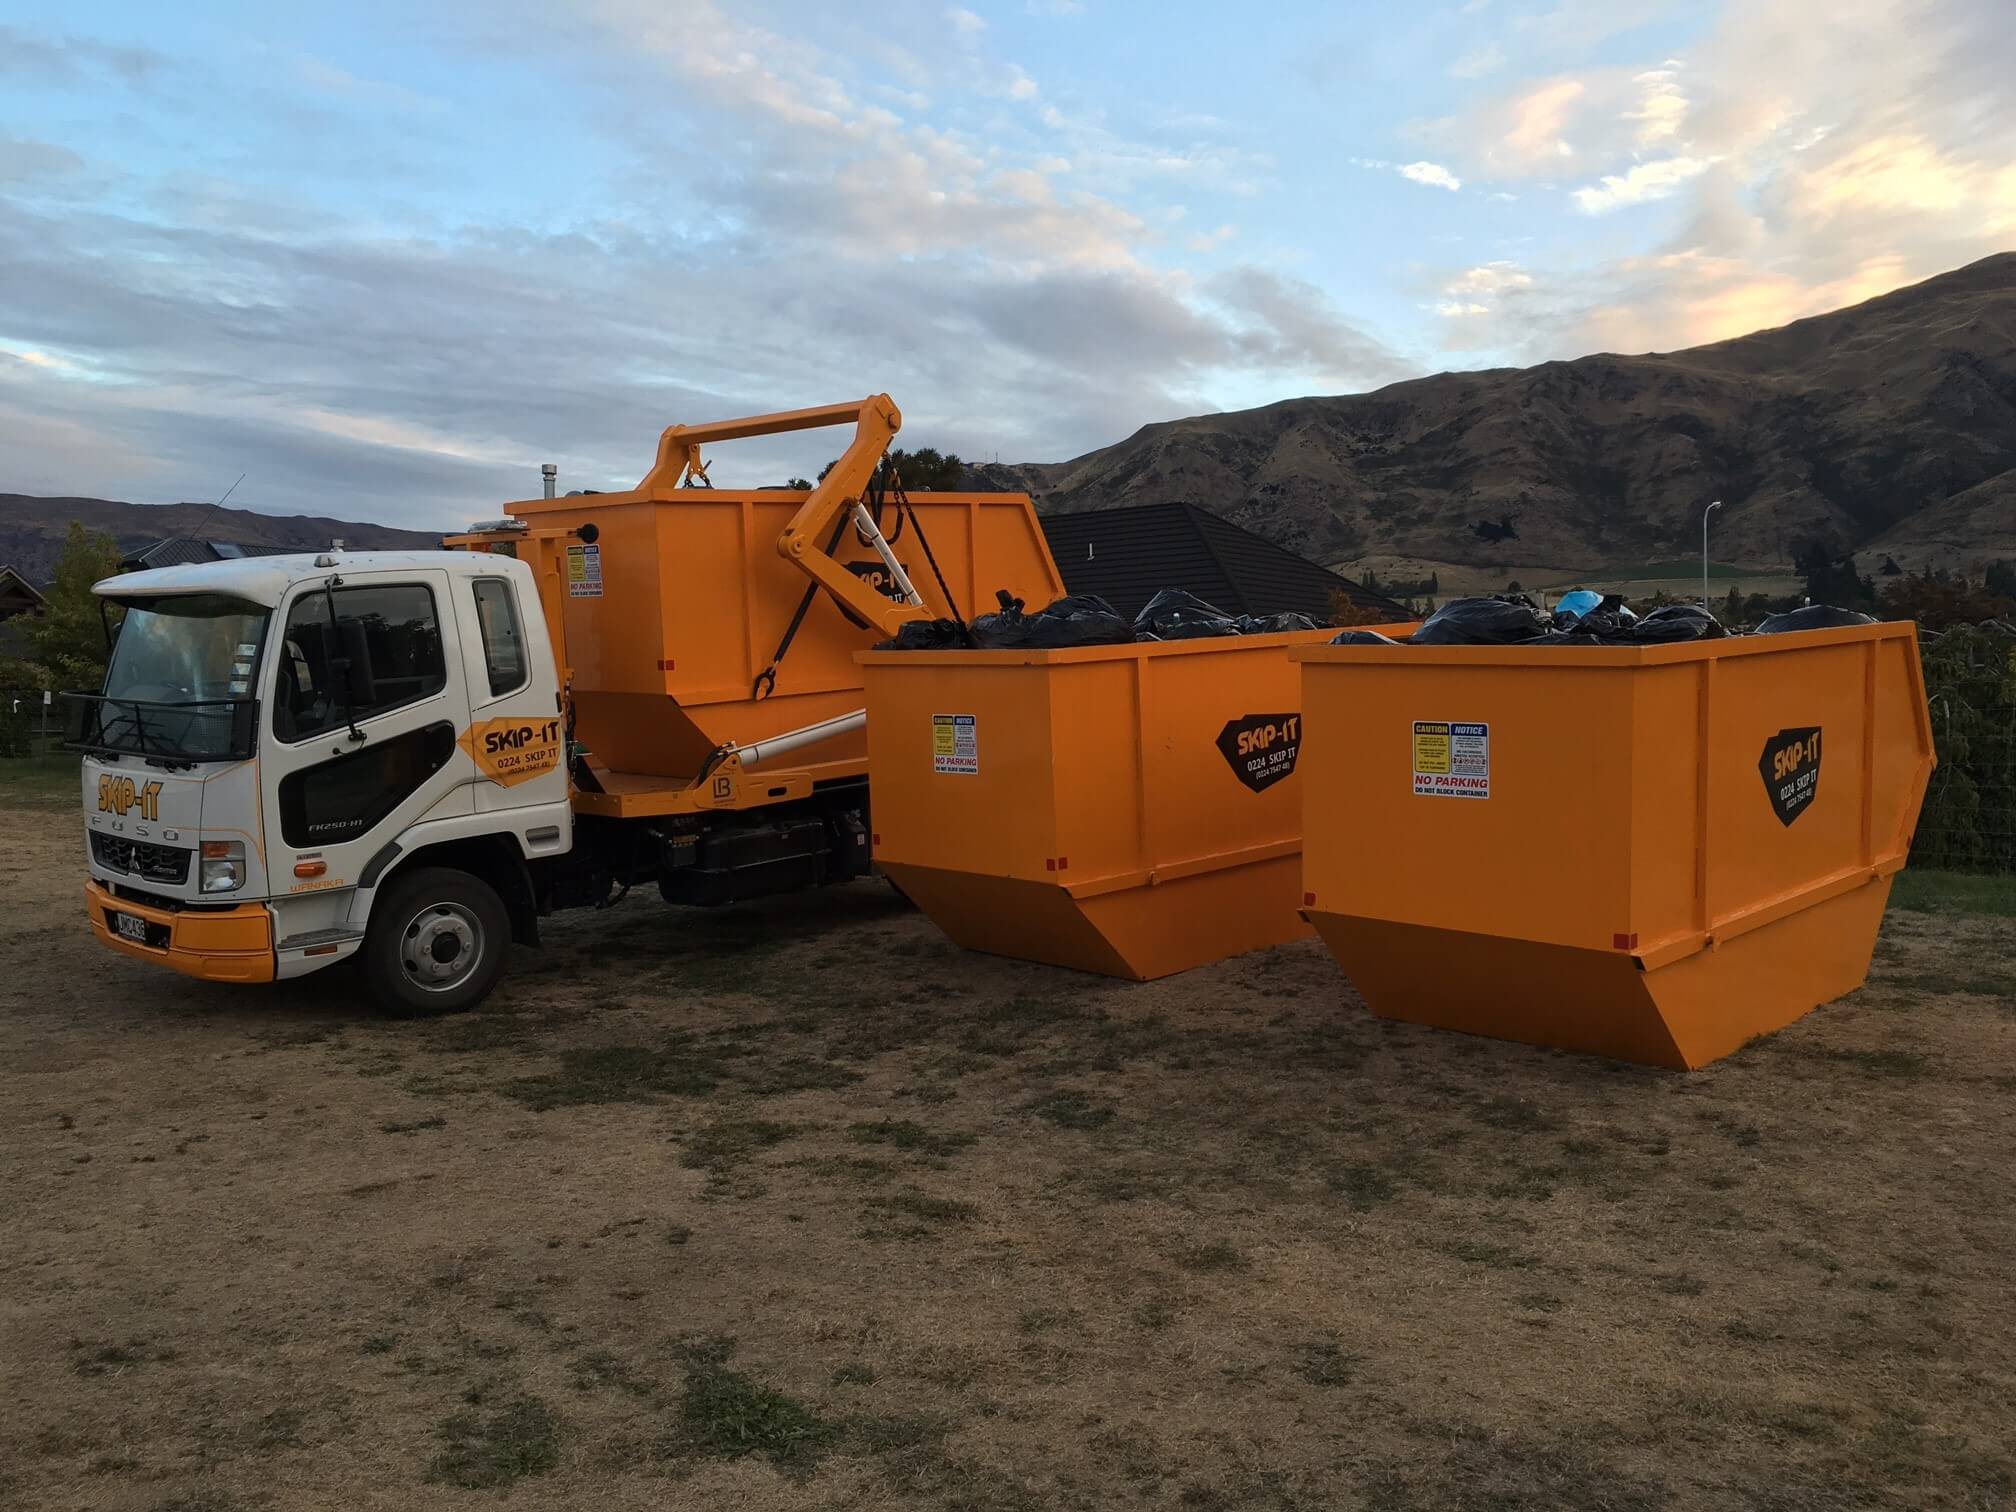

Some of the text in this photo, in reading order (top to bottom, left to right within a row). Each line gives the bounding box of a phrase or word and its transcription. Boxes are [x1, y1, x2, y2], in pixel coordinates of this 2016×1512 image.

[485, 721, 559, 754] SKIP-IT
[1237, 717, 1298, 756] SKIP-IT
[1415, 725, 1448, 734] CAUTION
[1455, 726, 1483, 734] NOTICE
[497, 748, 557, 769] 0224 SKIP IT
[946, 758, 977, 766] PARKING
[1247, 747, 1296, 772] 0224 SKIP IT
[1774, 731, 1820, 781] SKIP-IT
[1415, 775, 1488, 788] NO PARKING
[1781, 769, 1817, 801] 0224 SKIP IT
[98, 773, 164, 822] SKIP-IT
[92, 816, 179, 841] FUSO
[289, 879, 344, 892] WANAKA
